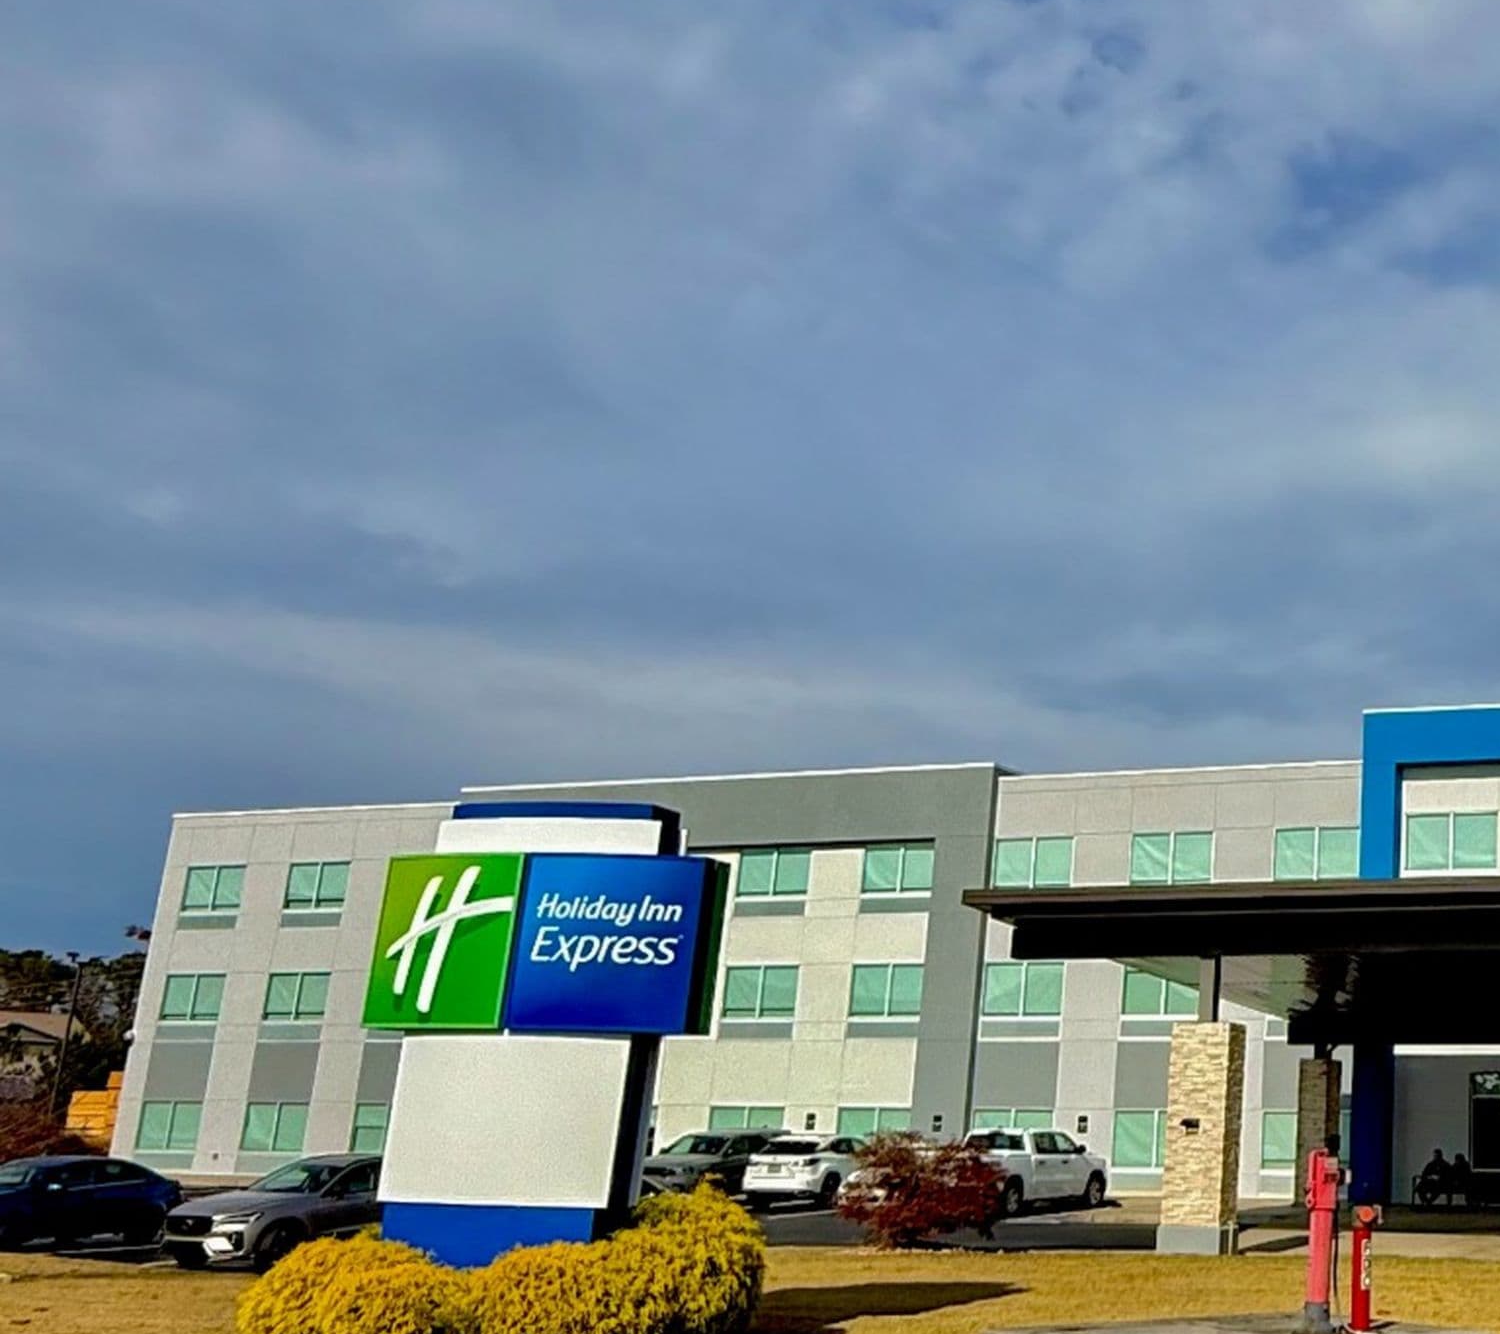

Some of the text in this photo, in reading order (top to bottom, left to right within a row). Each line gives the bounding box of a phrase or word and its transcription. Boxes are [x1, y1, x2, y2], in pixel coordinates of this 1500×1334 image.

[536, 892, 684, 927] Holiday Inn
[530, 925, 679, 972] Express
